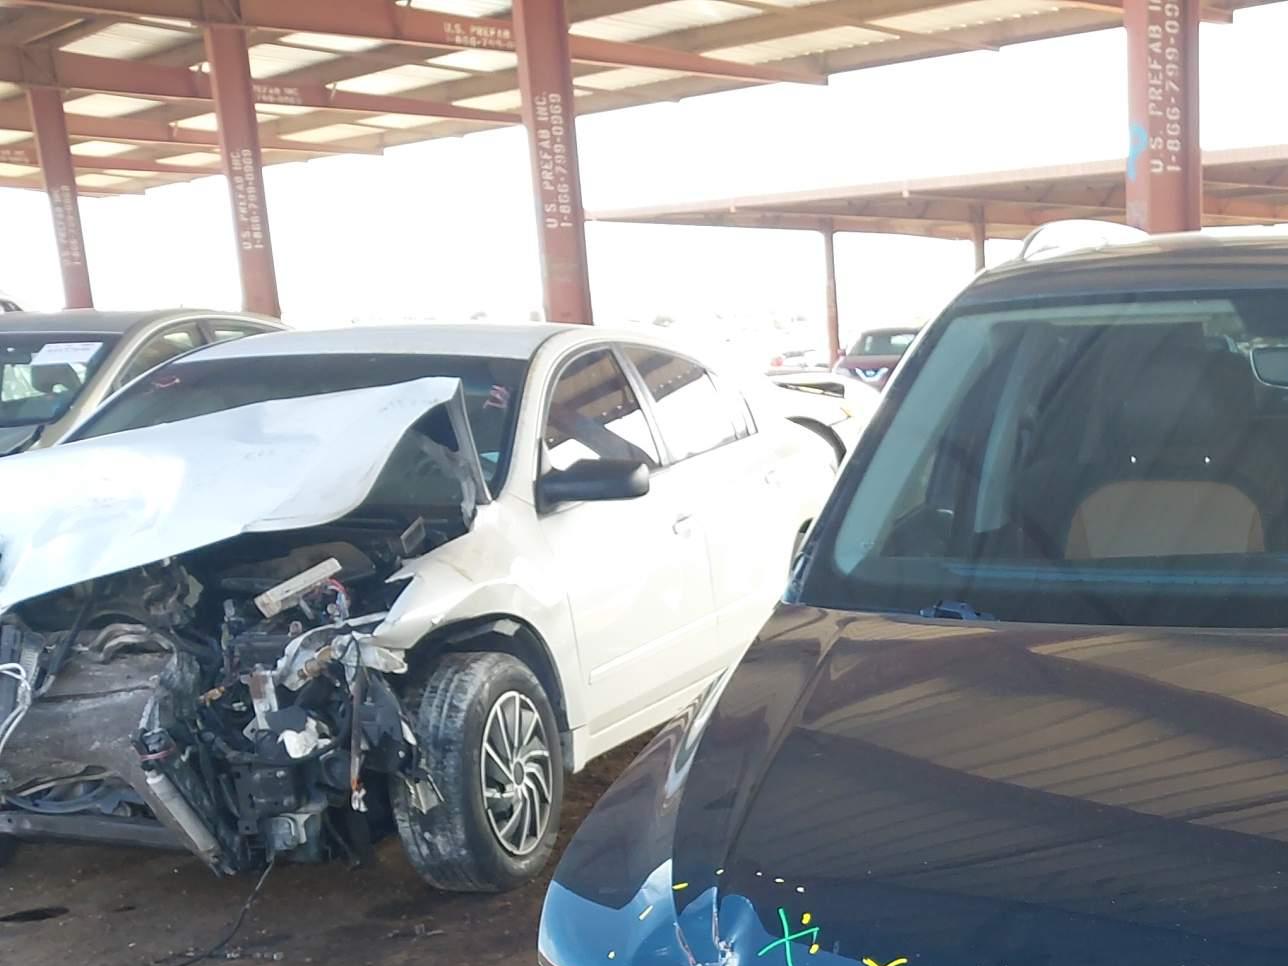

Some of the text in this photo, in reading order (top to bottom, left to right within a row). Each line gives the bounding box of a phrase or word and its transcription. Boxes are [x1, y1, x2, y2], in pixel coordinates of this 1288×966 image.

[1148, 25, 1163, 117] PREFAB
[537, 129, 555, 191] PREFAB
[548, 93, 573, 228] 1-866-799-0969
